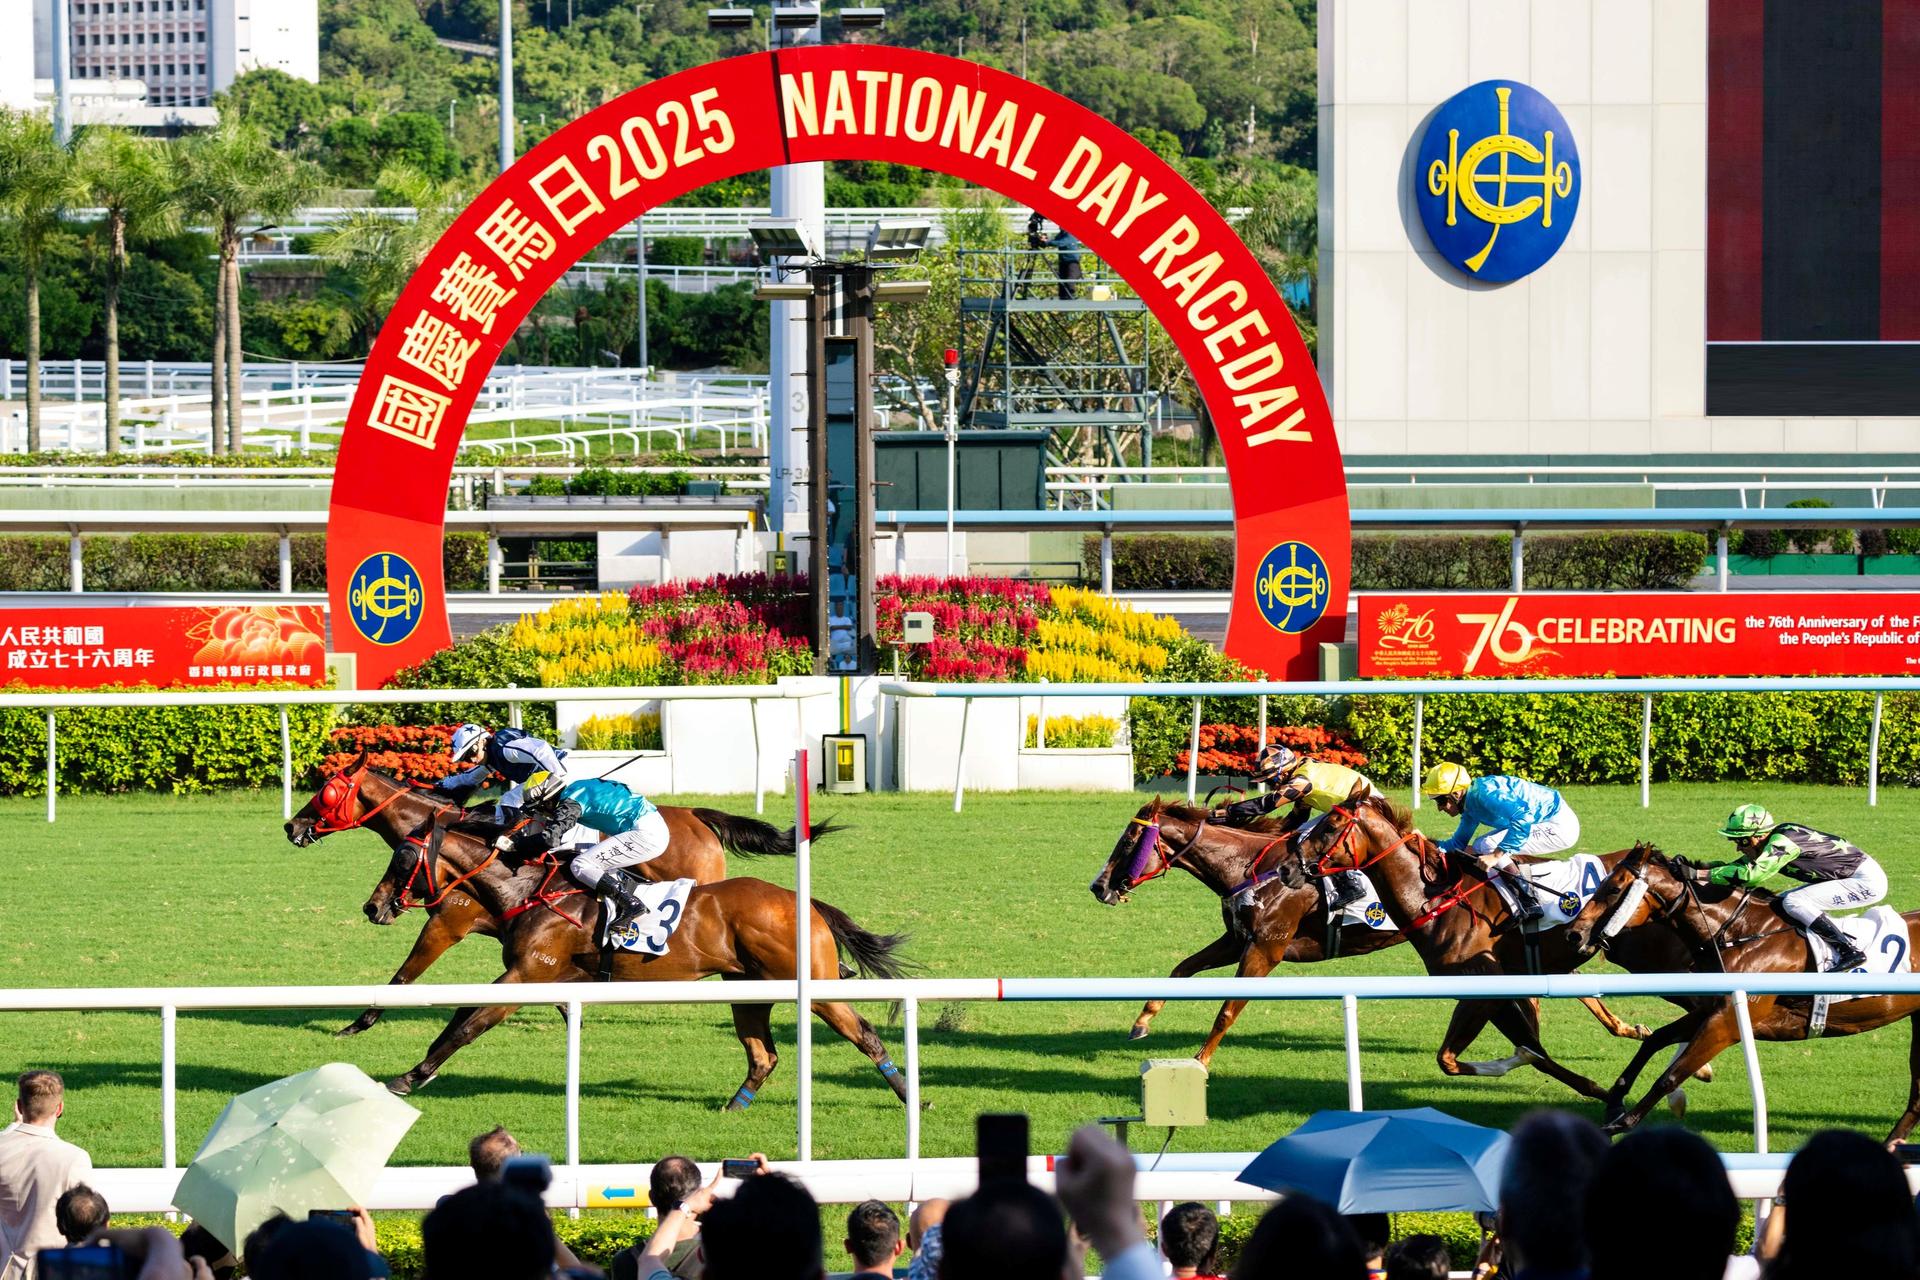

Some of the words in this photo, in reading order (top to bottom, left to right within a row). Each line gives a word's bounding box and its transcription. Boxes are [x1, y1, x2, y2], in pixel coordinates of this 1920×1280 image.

[780, 70, 1046, 181] NATIONAL
[1048, 135, 1169, 239] DAY
[1138, 214, 1313, 448] RACEDAY
[791, 392, 804, 413] 3
[0, 626, 104, 646] 人民共和國
[1402, 608, 1435, 644] 76
[1456, 597, 1532, 673] 76
[1537, 617, 1736, 644] CELEBRATING
[1745, 616, 1765, 628] the
[1768, 616, 1794, 628] 76th
[1798, 615, 1868, 631] Anniversary
[1871, 615, 1885, 628] of
[1890, 615, 1910, 628] the
[1779, 631, 1799, 645] the
[1802, 631, 1850, 648] People's
[1853, 631, 1904, 648] Republic
[1907, 631, 1920, 645] of
[8, 648, 155, 669] 成立七十六周年
[647, 898, 681, 952] 3
[1880, 934, 1907, 973] 2
